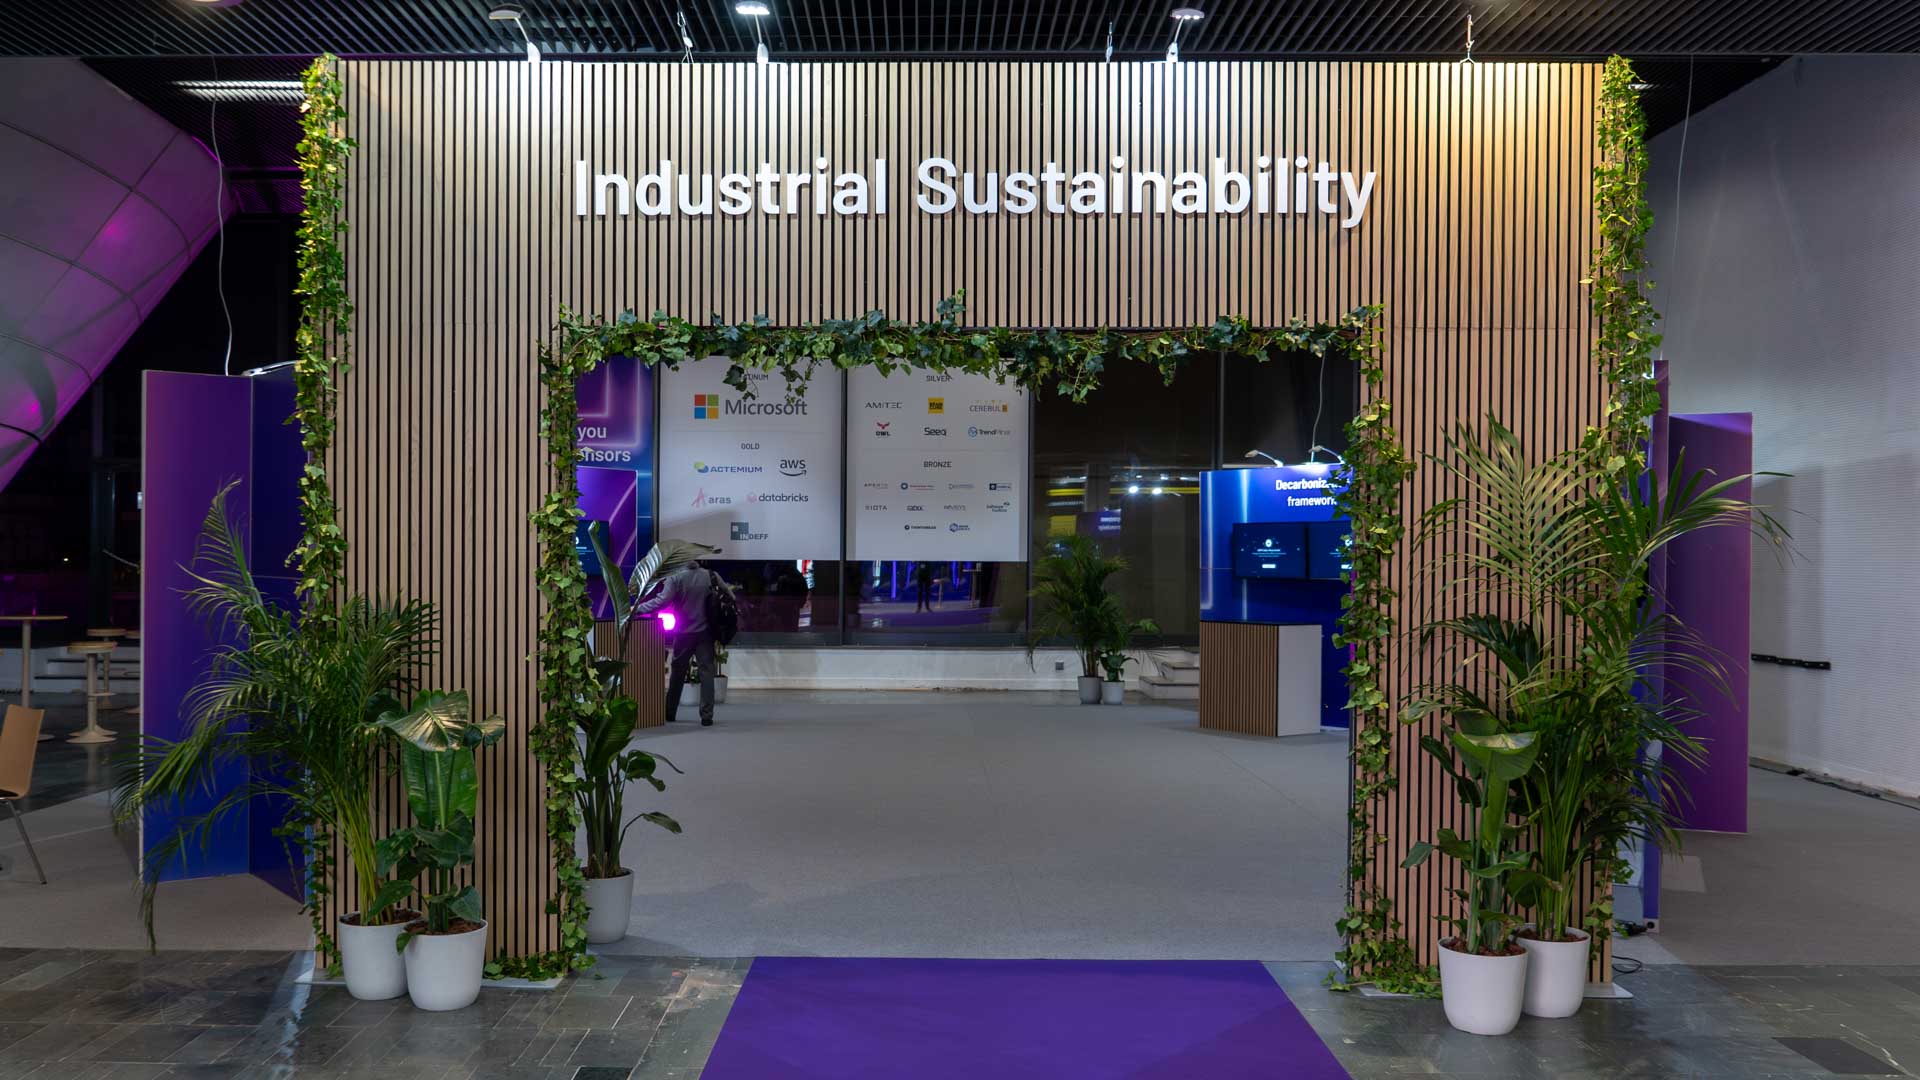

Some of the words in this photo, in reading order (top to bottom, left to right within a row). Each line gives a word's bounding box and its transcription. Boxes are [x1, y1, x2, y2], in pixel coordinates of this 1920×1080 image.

[575, 156, 886, 217] Industrial
[916, 156, 1377, 229] Sustainability
[725, 399, 808, 416] Microsoft
[577, 427, 607, 442] you
[924, 427, 947, 437] Seeq
[779, 459, 806, 469] aws
[1275, 477, 1349, 491] Decarboniz
[708, 495, 732, 504] aras
[758, 493, 809, 502] databricks
